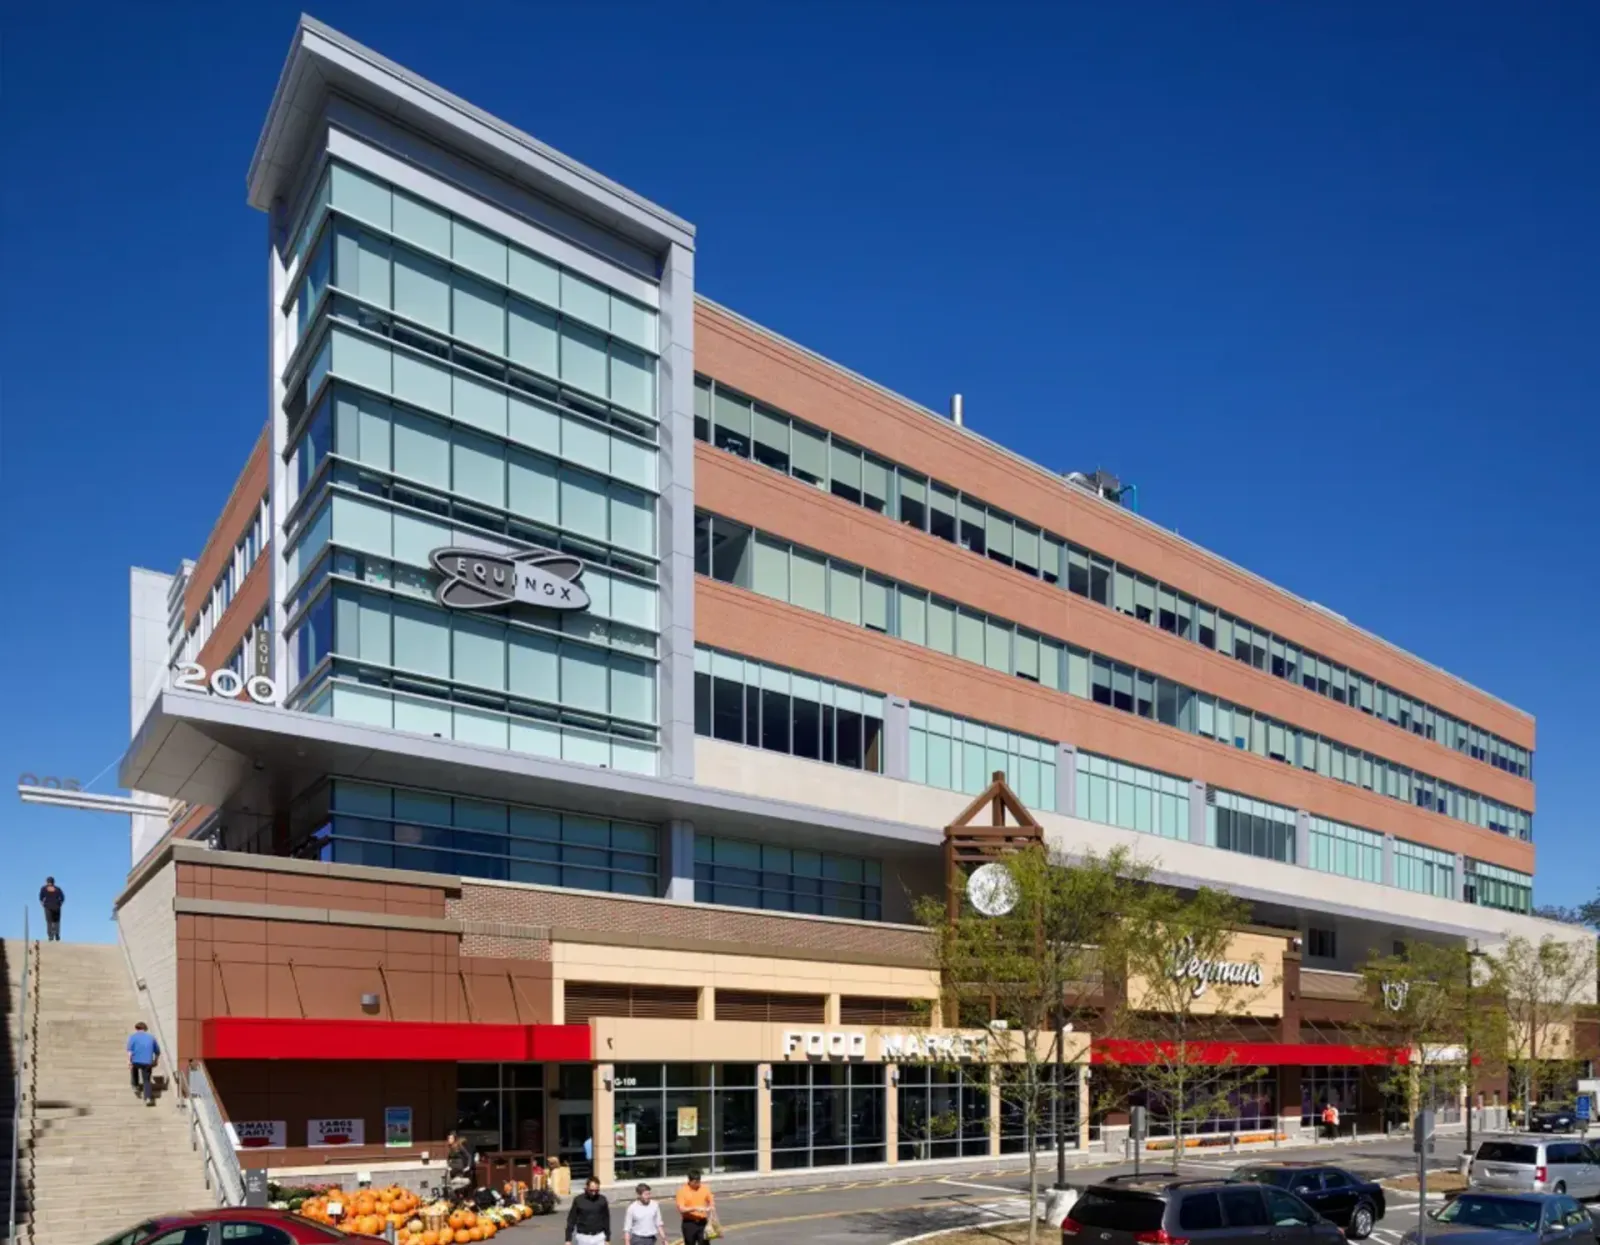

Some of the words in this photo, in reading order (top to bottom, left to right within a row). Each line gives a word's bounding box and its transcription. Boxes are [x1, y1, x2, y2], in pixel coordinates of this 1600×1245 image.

[457, 557, 571, 601] EQUINOX
[173, 662, 276, 705] 200
[783, 1031, 866, 1062] FOOD
[878, 1034, 988, 1064] MARKET
